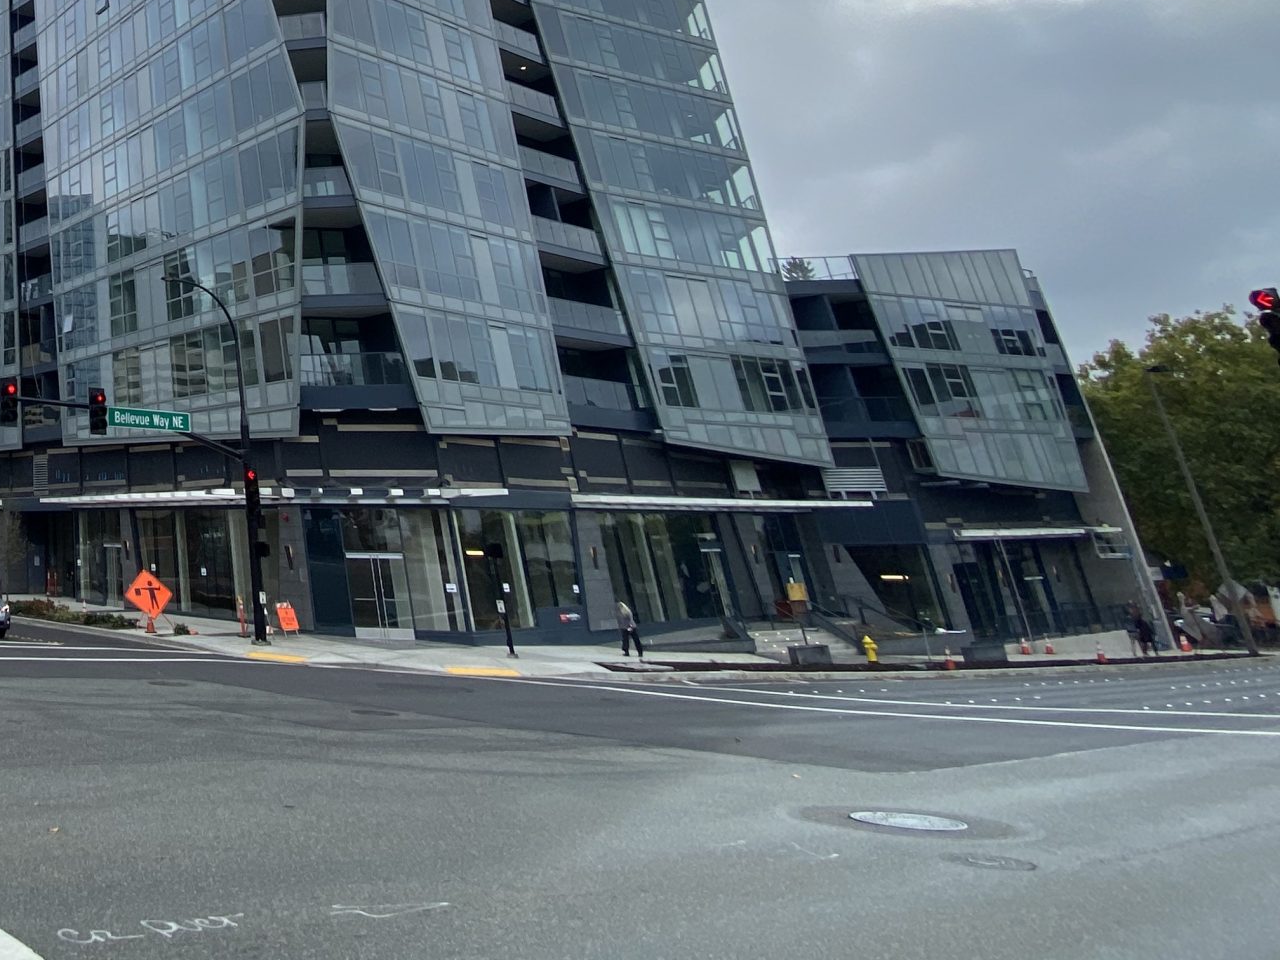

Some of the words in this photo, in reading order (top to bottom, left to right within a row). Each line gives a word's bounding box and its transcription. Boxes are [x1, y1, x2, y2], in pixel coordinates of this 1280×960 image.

[114, 411, 150, 426] Bellevue
[152, 414, 169, 430] Way
[172, 416, 184, 429] NE
